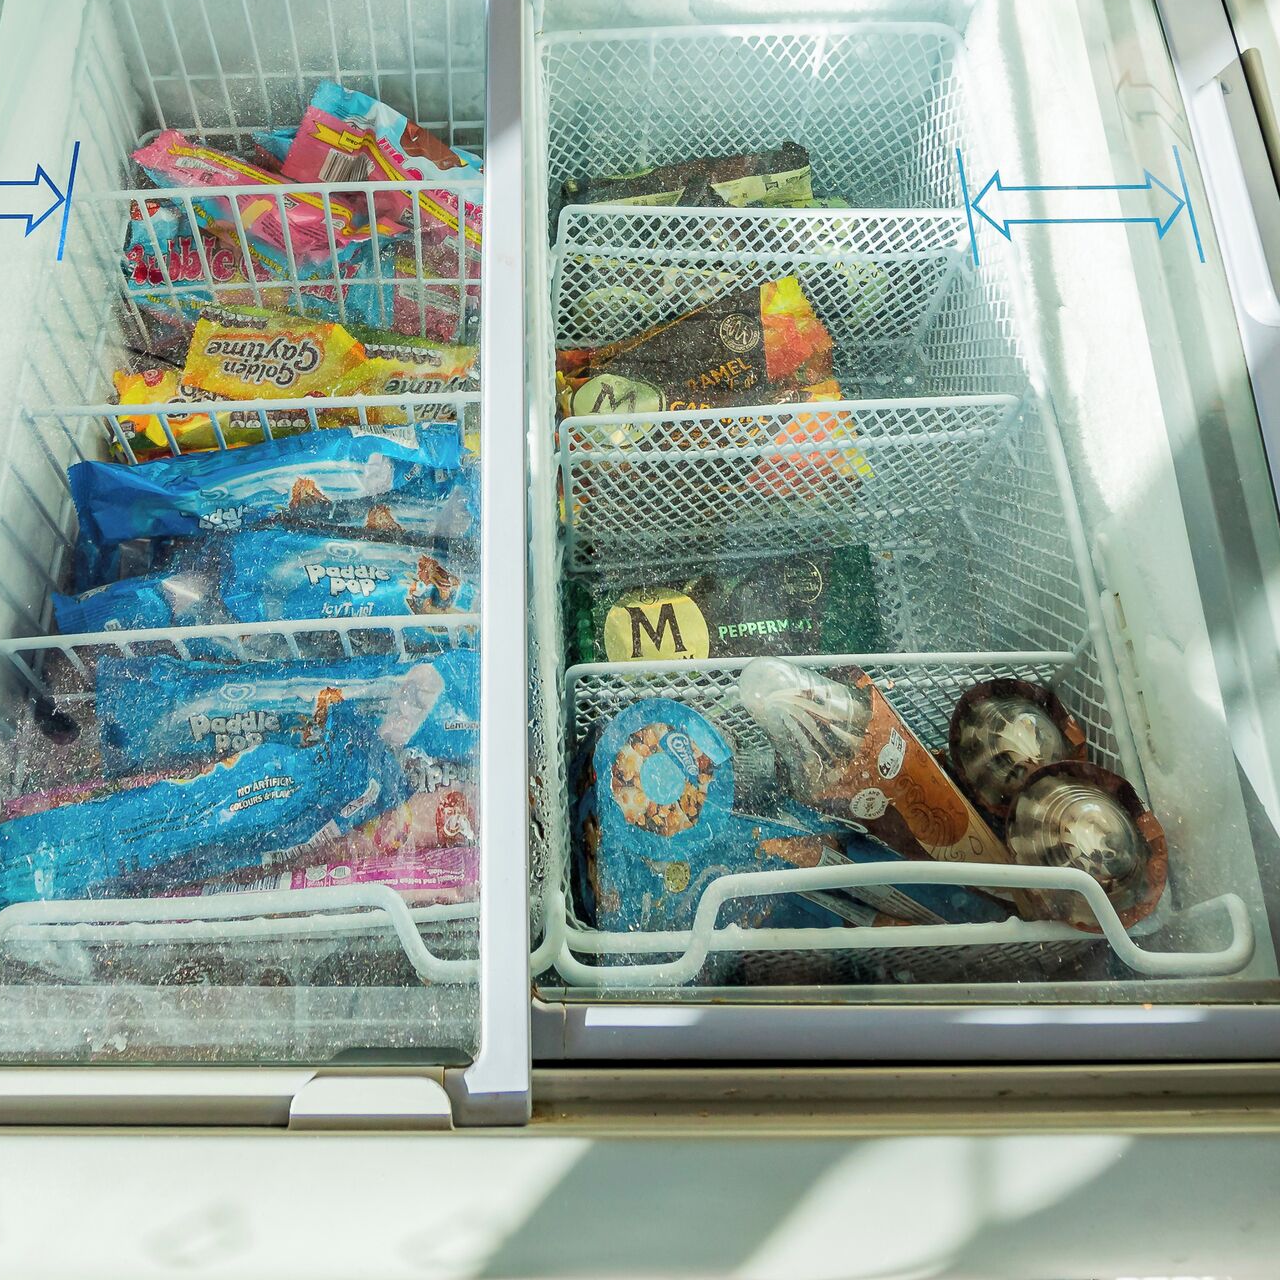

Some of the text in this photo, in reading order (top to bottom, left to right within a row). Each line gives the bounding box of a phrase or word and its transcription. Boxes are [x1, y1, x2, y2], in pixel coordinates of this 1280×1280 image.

[206, 336, 321, 372] Gaytime
[222, 359, 295, 387] Golden
[624, 602, 687, 658] M
[229, 794, 263, 812] COLOURS
[237, 785, 252, 797] NO
